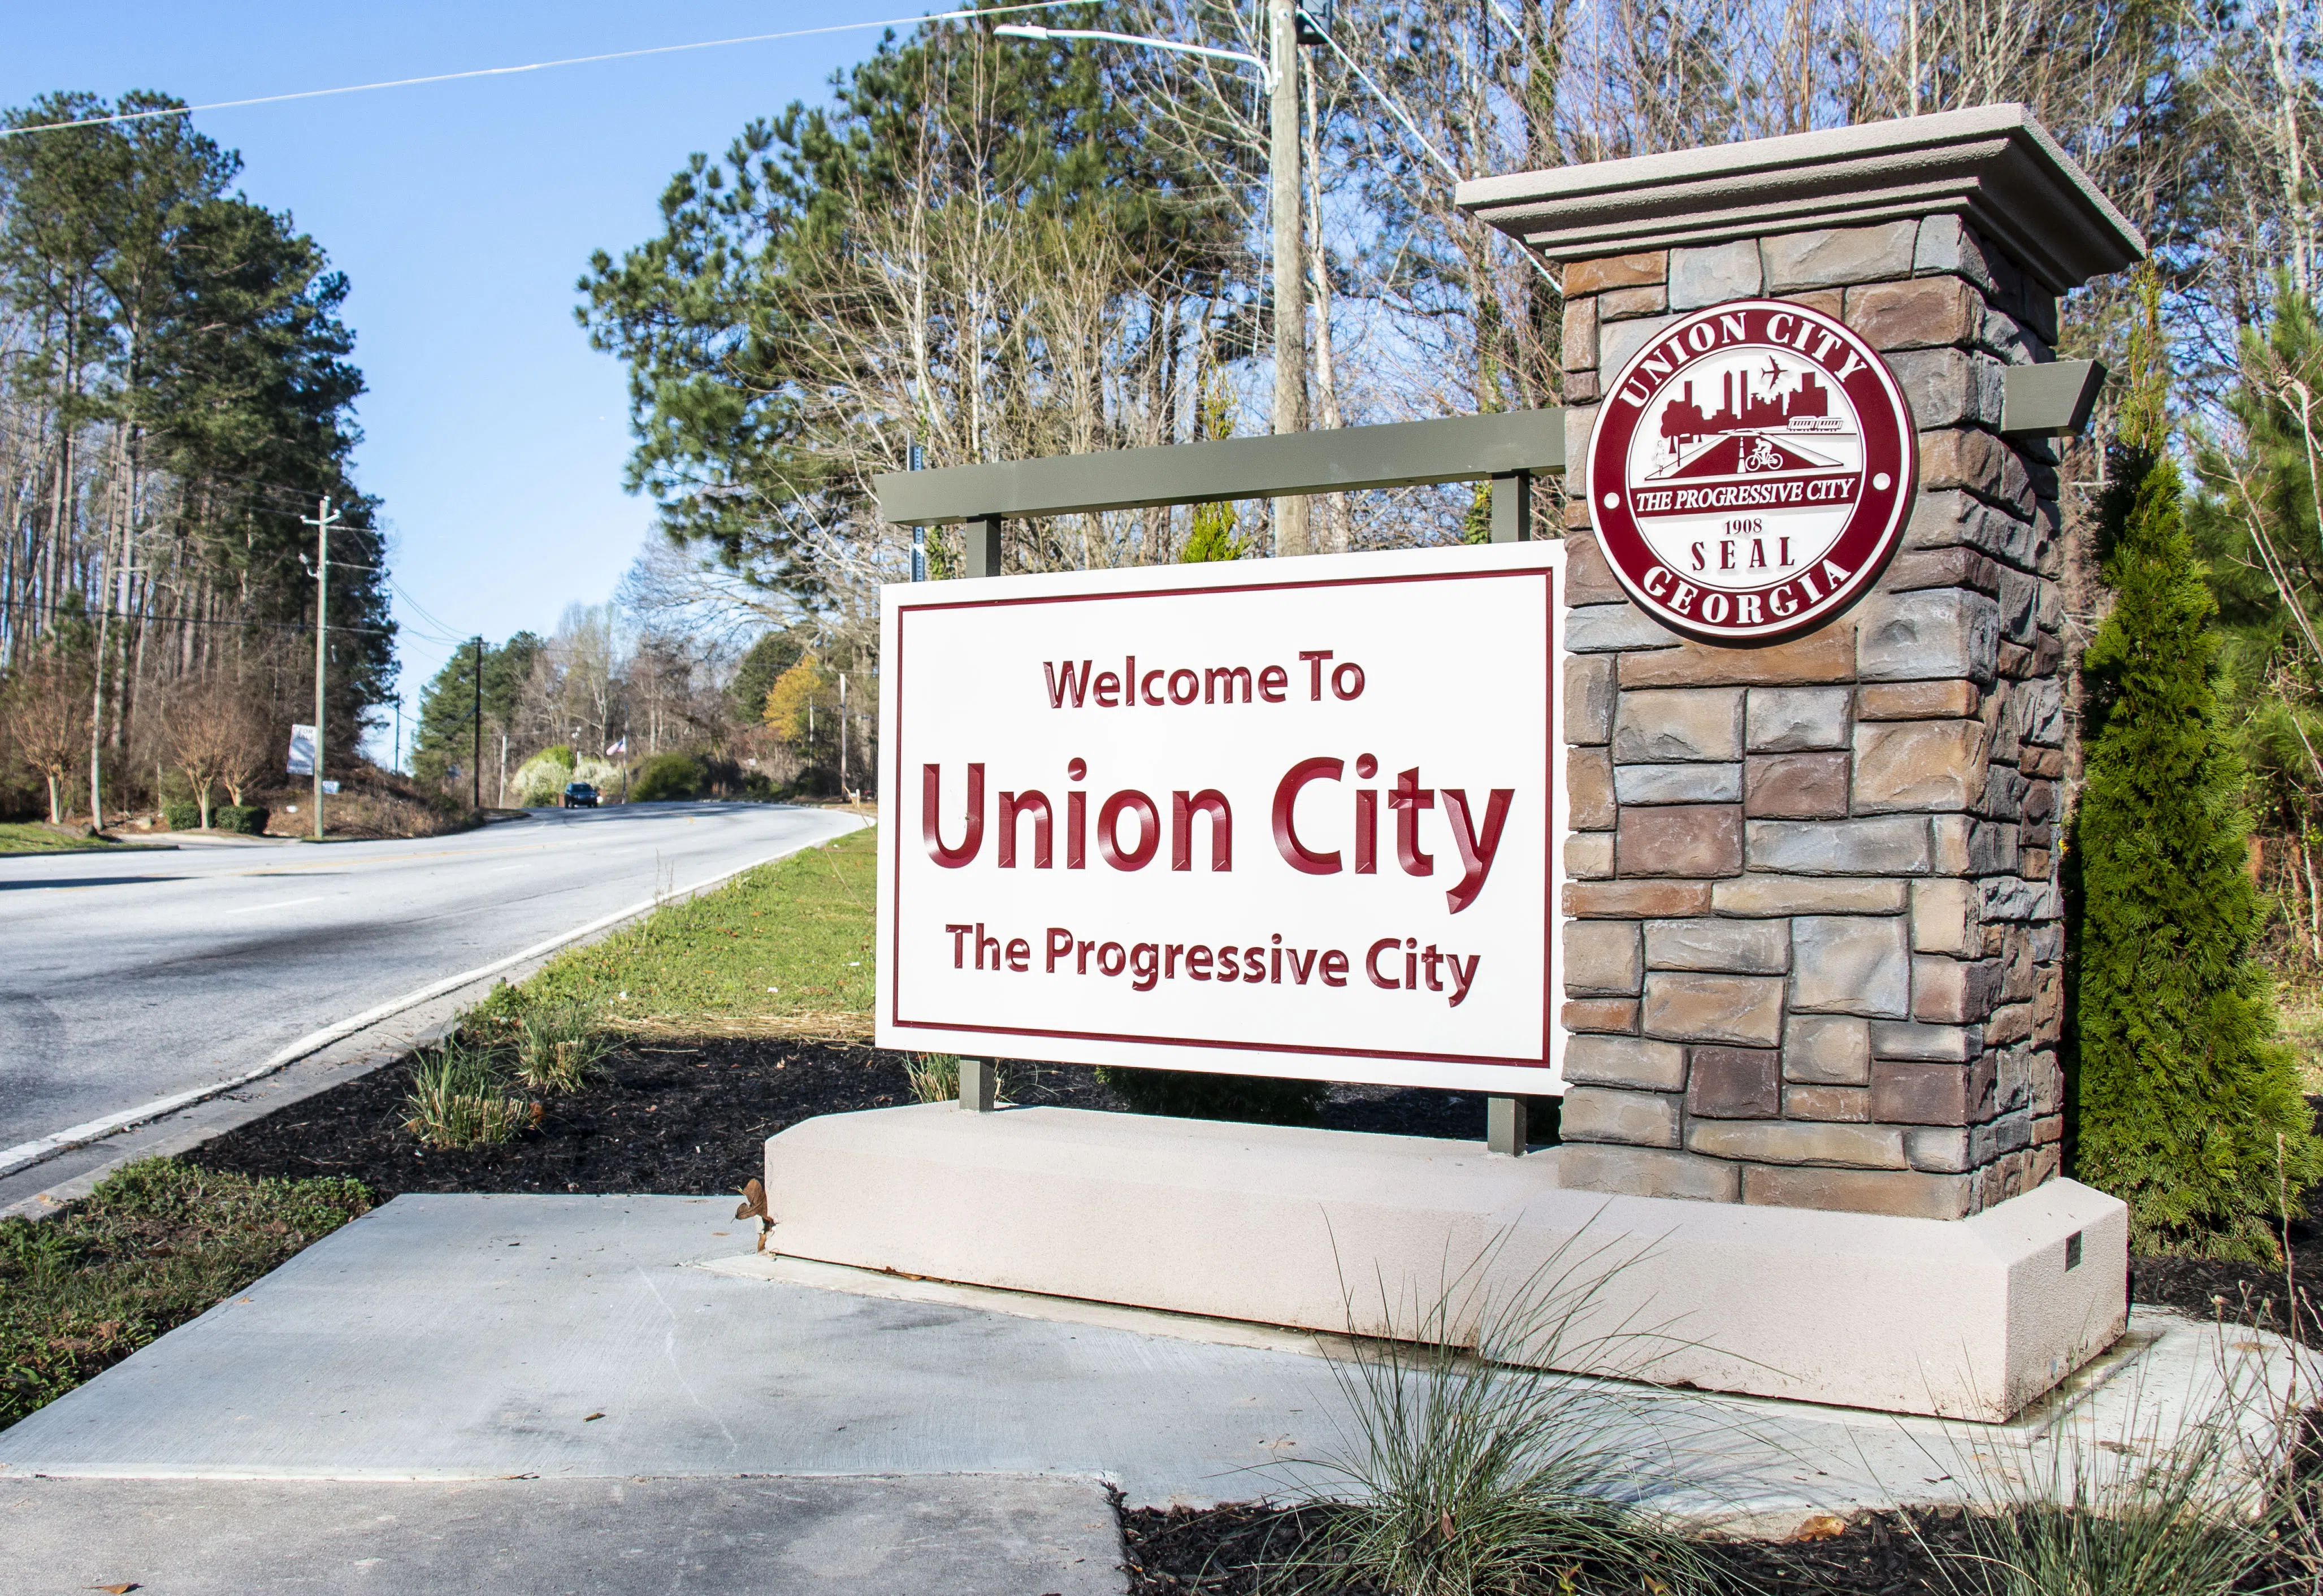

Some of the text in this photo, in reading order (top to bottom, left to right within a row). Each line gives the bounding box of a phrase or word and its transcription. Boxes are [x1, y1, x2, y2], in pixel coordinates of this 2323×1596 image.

[1618, 311, 1867, 409] UNION CITY
[1636, 478, 1856, 512] THE PROGRESSIVE CITY
[1691, 536, 1796, 571] SEAL
[1724, 518, 1762, 535] 1908
[1642, 558, 1852, 624] GEORGIA
[1043, 650, 1365, 709] Welcome To
[922, 753, 1515, 914] Union City
[946, 923, 1481, 1008] The Progressive City
